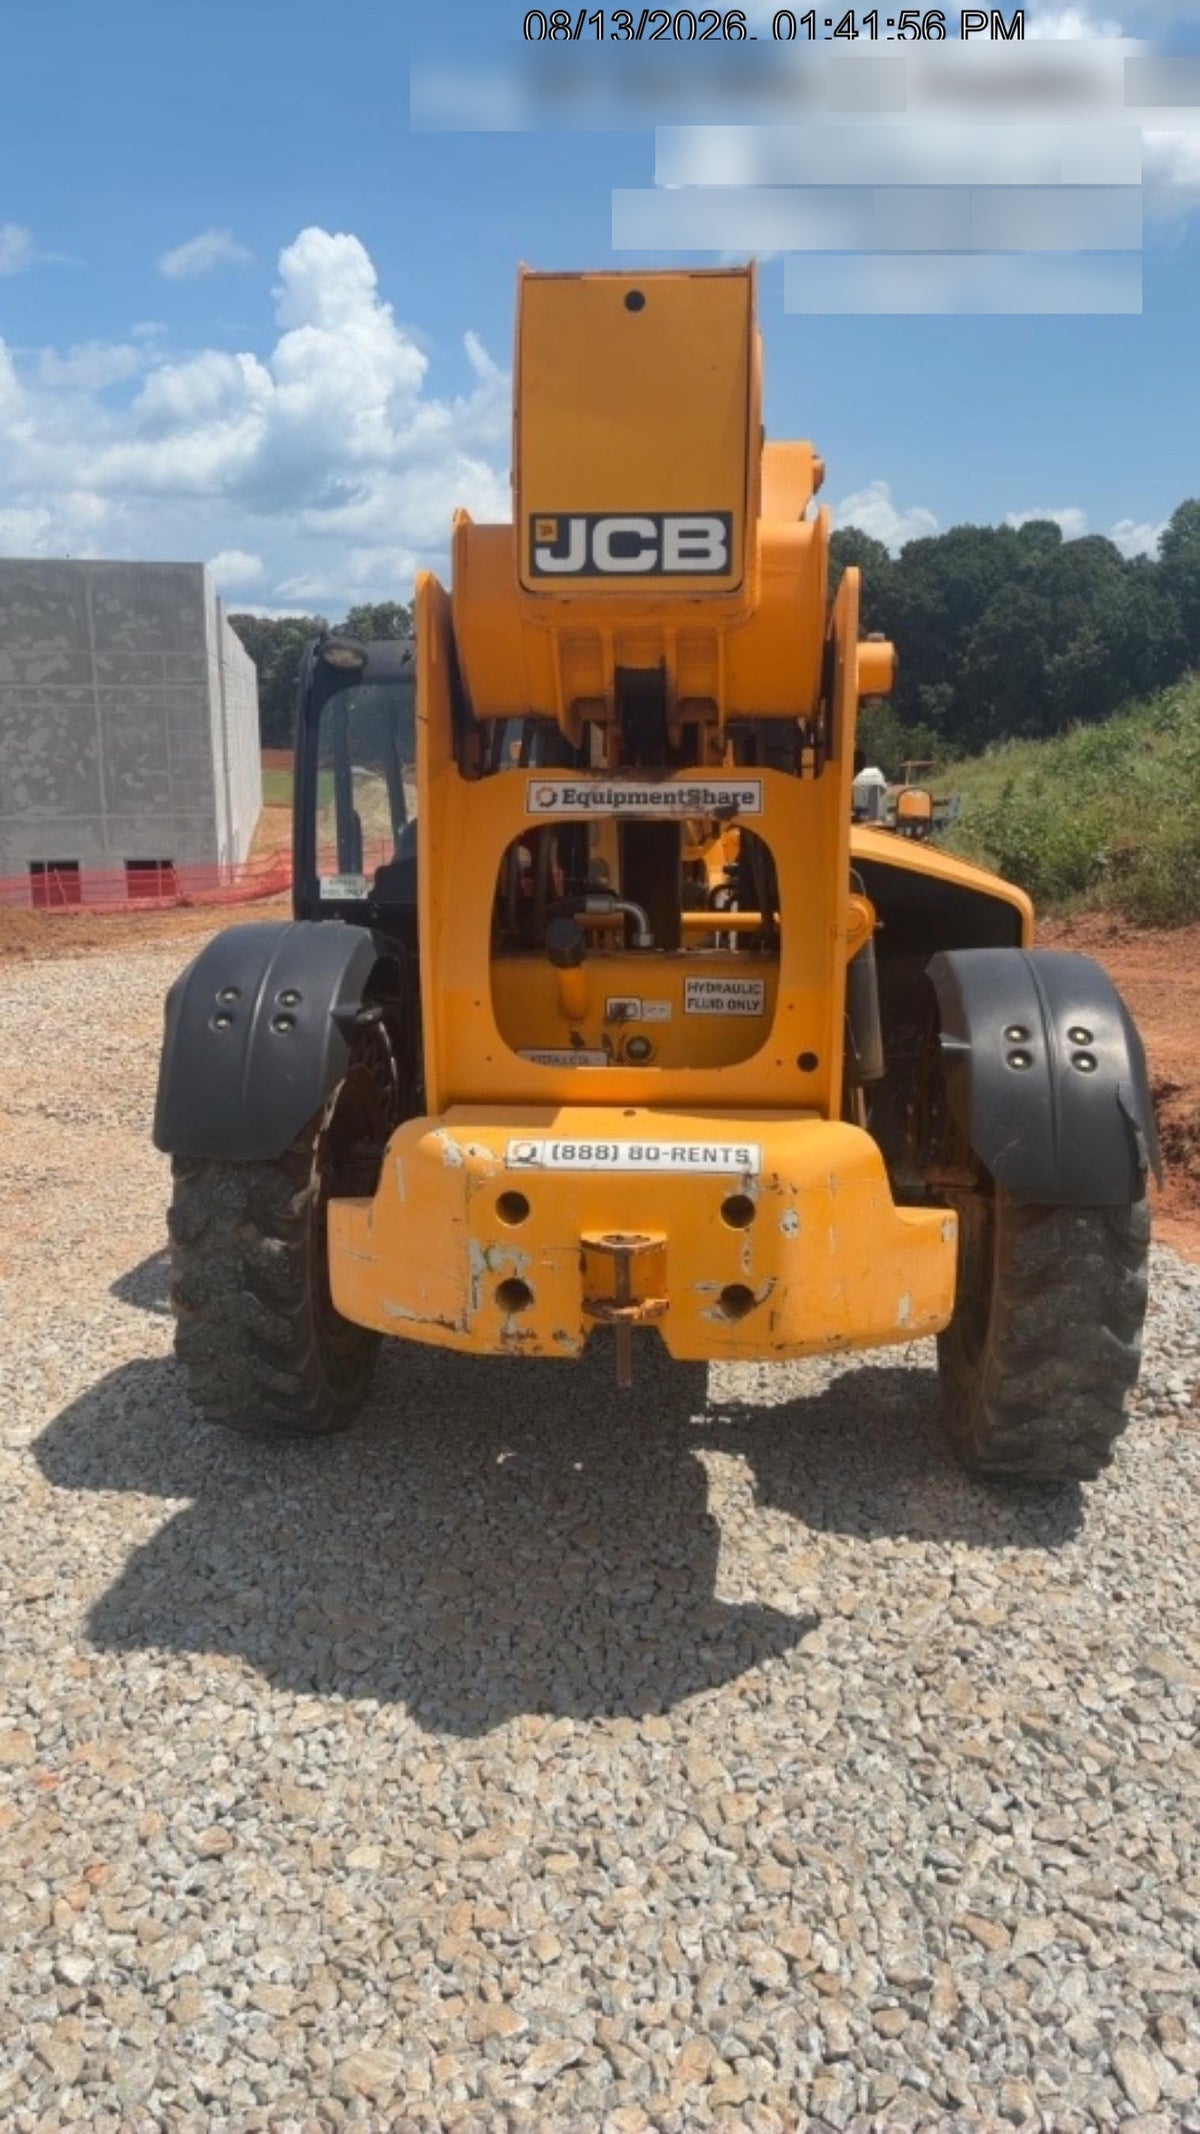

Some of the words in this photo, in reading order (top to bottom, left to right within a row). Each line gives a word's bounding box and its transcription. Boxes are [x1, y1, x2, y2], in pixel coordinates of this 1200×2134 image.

[535, 516, 728, 572] JCB
[561, 787, 755, 809] EquipmentShare
[687, 981, 762, 994] HYDRAULIC
[687, 998, 723, 1009] FLUID
[727, 999, 761, 1011] ONLY
[552, 1144, 620, 1162] (888)
[628, 1145, 751, 1164] 80-RENTS
